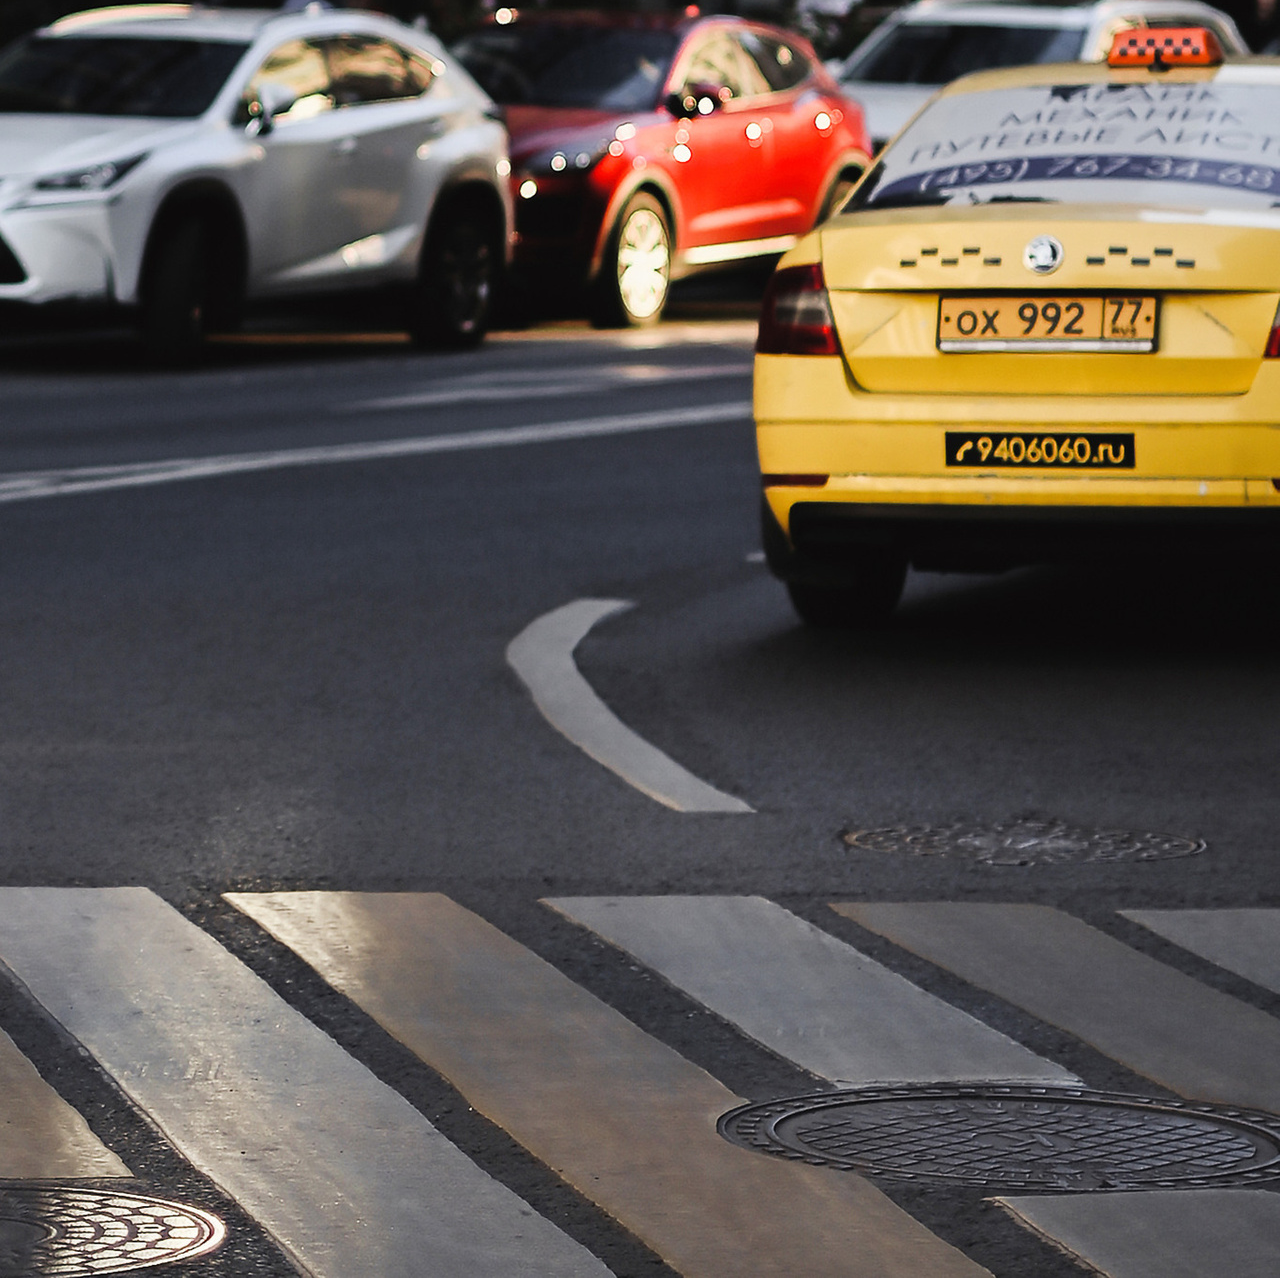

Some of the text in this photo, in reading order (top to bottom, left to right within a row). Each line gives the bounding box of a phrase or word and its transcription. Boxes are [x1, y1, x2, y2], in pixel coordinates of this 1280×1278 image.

[1000, 105, 1243, 126] МЕХАНИК
[910, 127, 1280, 164] ПУТЕВЫЕ ЛИСТ
[920, 156, 1275, 191] (495) 767-34-68
[1018, 302, 1085, 335] 992
[1108, 299, 1144, 325] 77
[977, 436, 1125, 464] 9406060.ru
